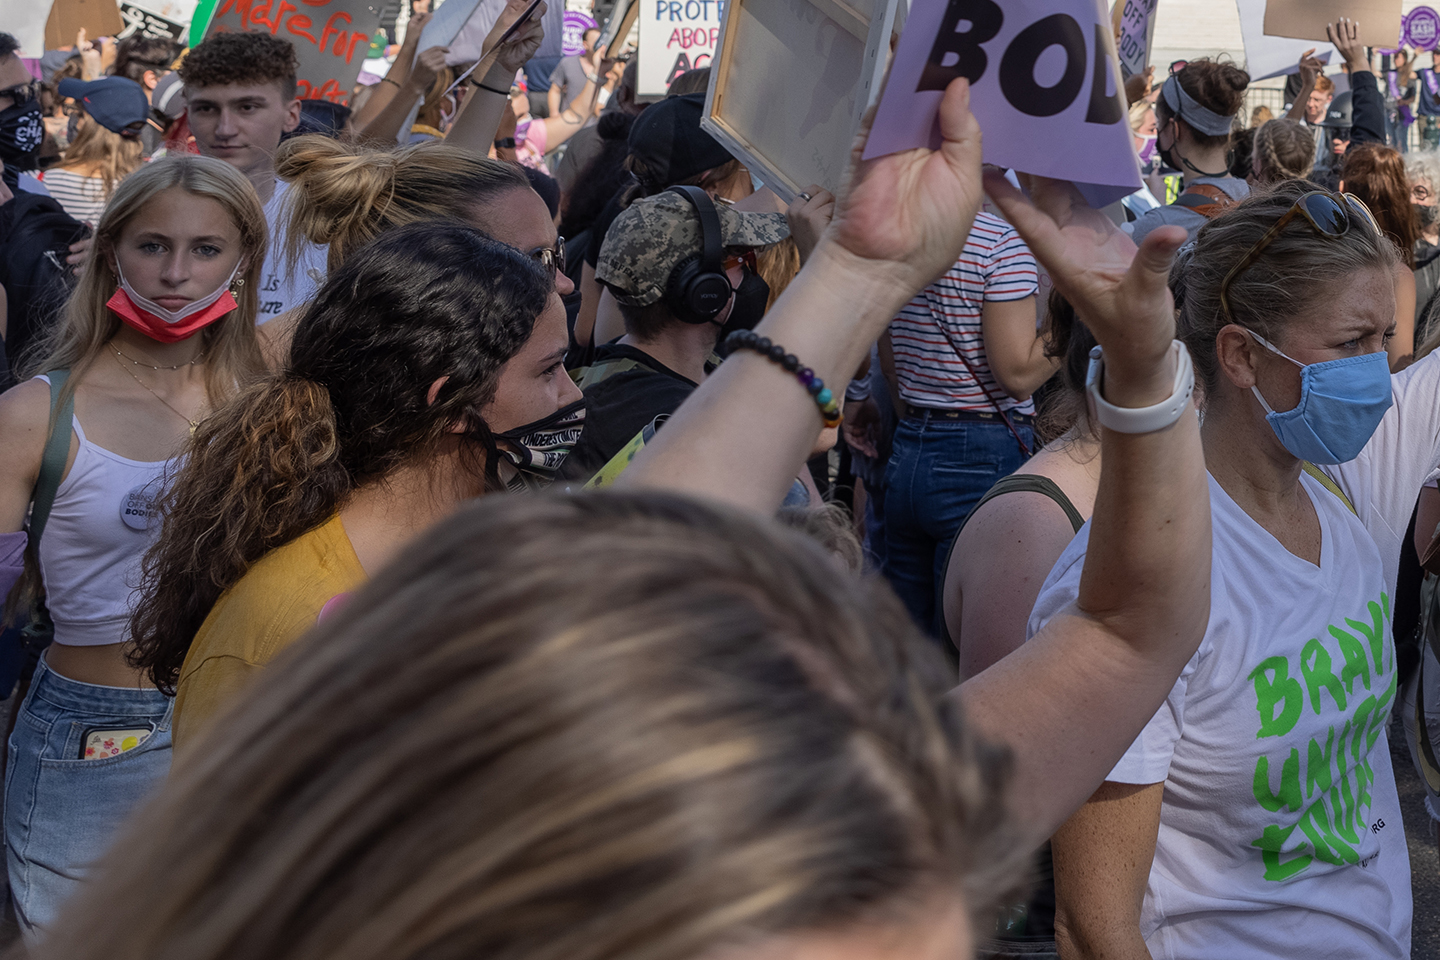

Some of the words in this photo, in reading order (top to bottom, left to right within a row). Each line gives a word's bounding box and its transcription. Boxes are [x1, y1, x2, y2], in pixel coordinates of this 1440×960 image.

[1123, 0, 1144, 29] OFF
[261, 274, 280, 292] Is
[1370, 818, 1386, 834] RG
